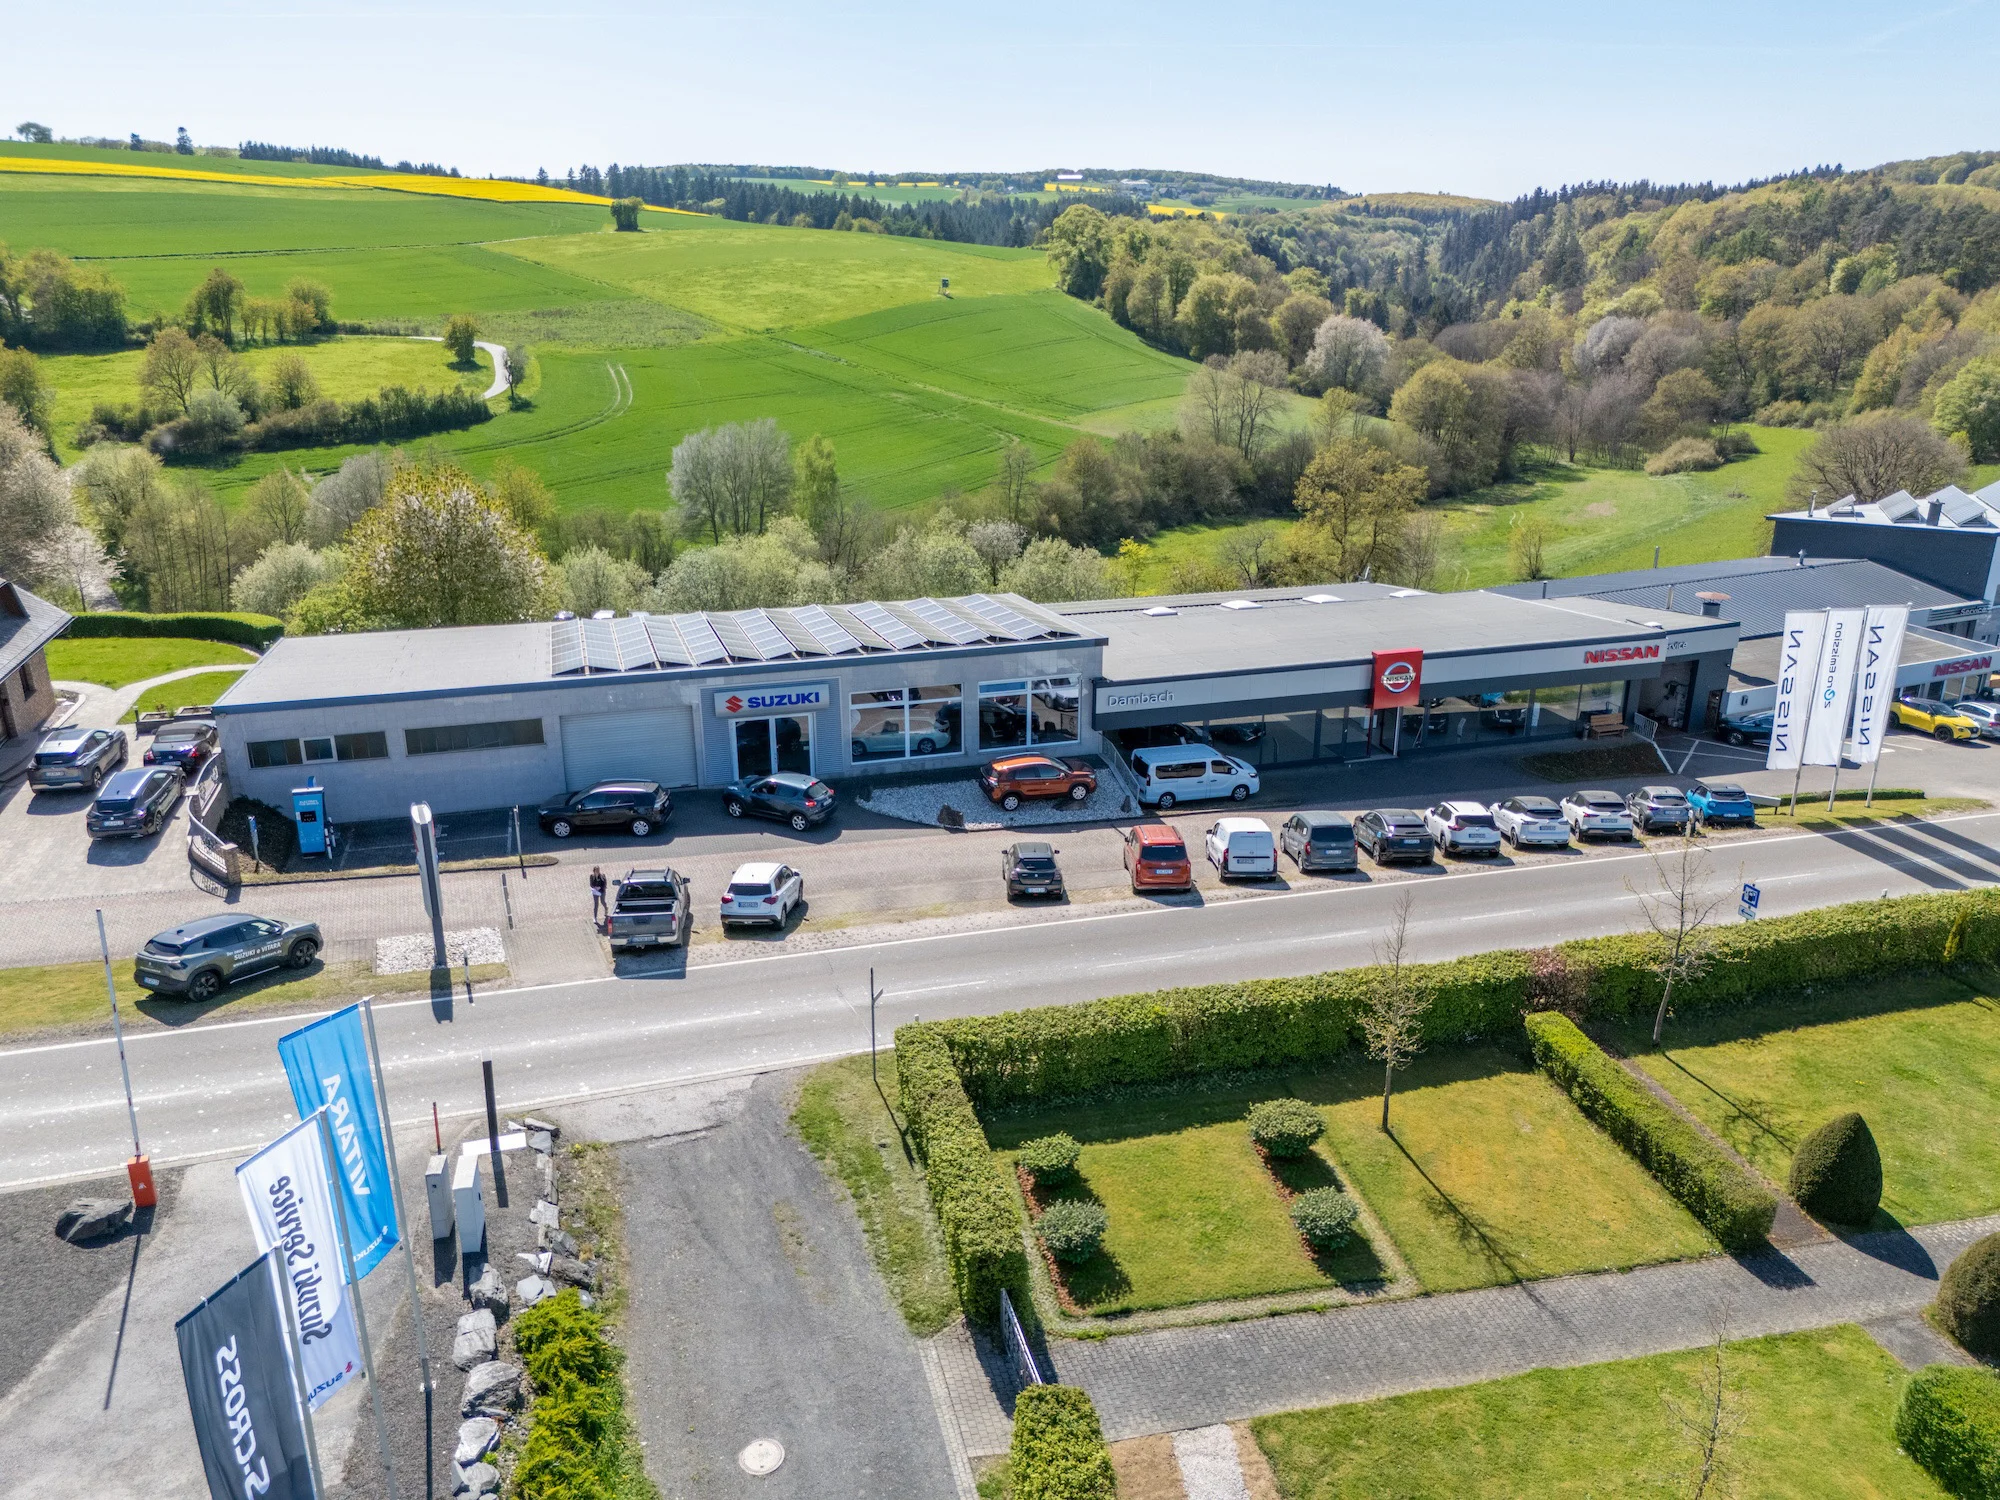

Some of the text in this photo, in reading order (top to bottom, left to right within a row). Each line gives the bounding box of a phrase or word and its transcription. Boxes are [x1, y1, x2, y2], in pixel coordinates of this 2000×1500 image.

[1961, 605, 1987, 616] Service
[1584, 645, 1660, 664] NISSAN
[1933, 655, 1992, 677] NISSAN
[1386, 674, 1414, 682] NISSAN
[747, 692, 820, 708] SUZUKI
[1108, 690, 1175, 707] Dambach
[234, 948, 256, 961] SUZUKI
[261, 941, 282, 953] VITARA
